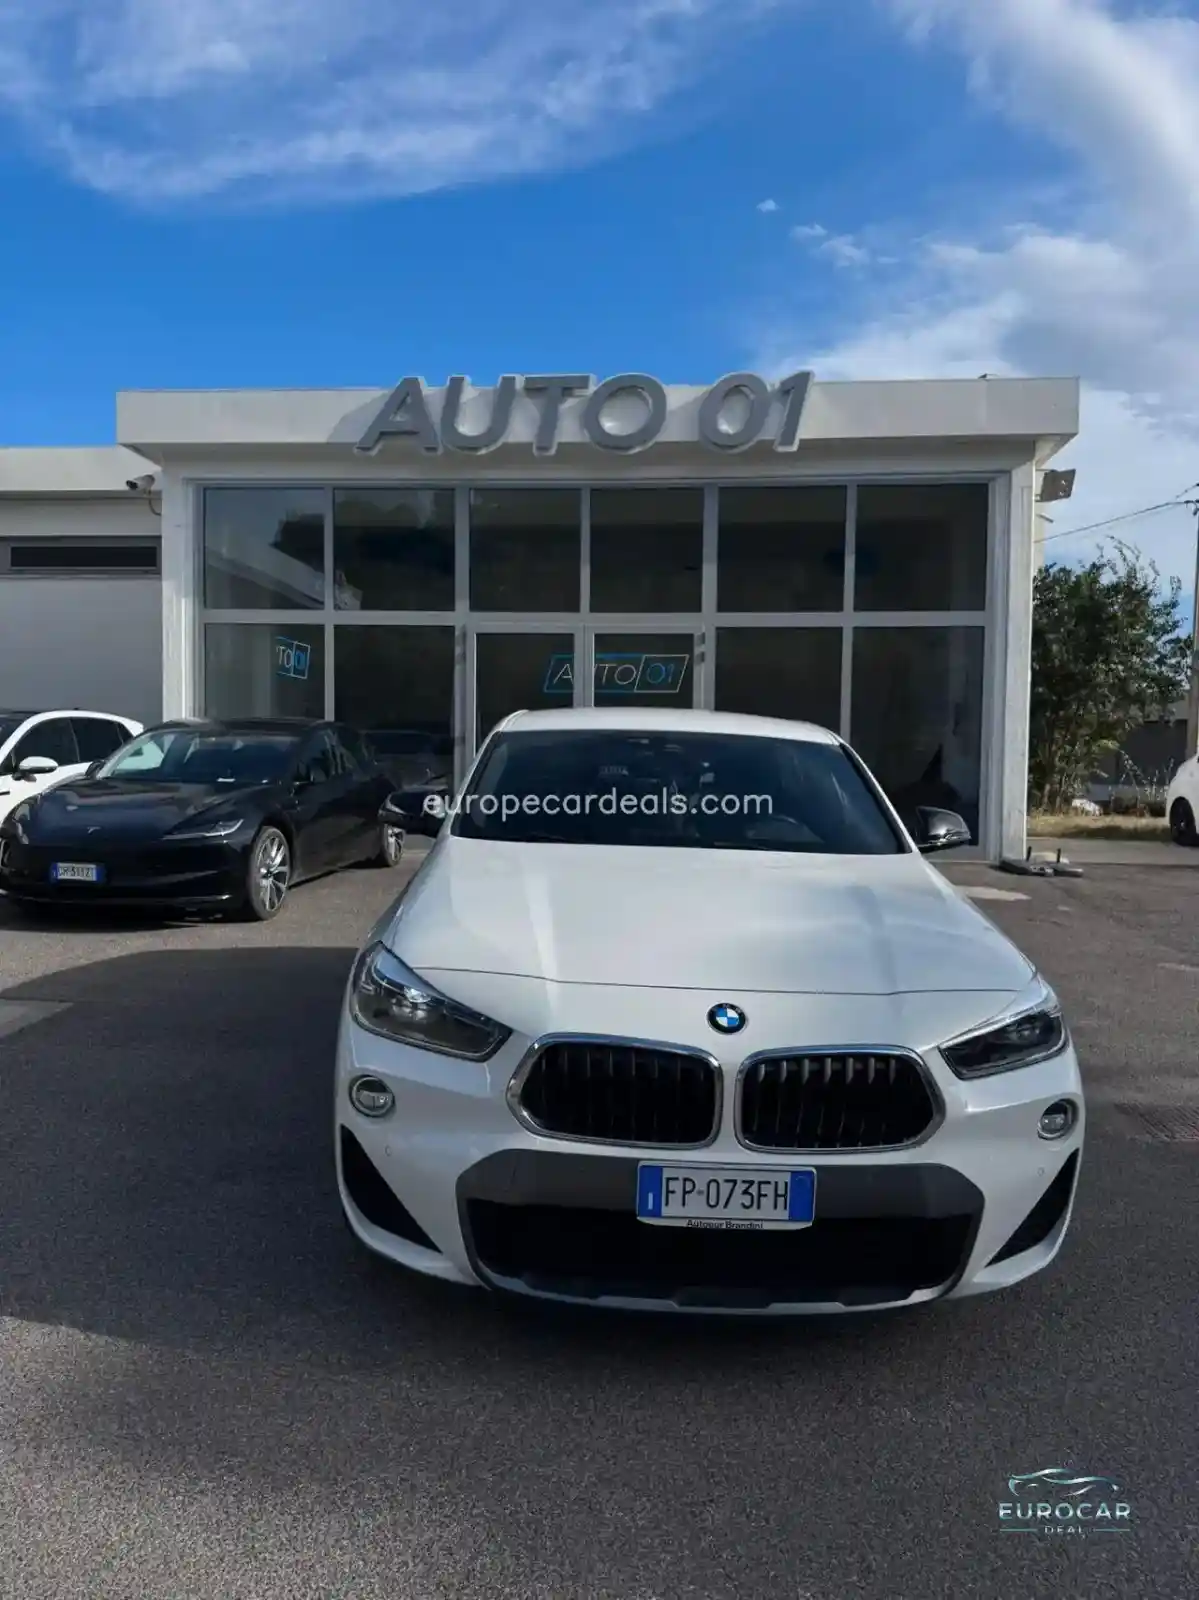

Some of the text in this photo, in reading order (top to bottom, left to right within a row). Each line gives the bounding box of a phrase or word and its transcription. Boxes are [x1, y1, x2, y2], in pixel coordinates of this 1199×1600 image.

[354, 371, 815, 455] AUTO 01
[553, 662, 675, 685] ATO 01
